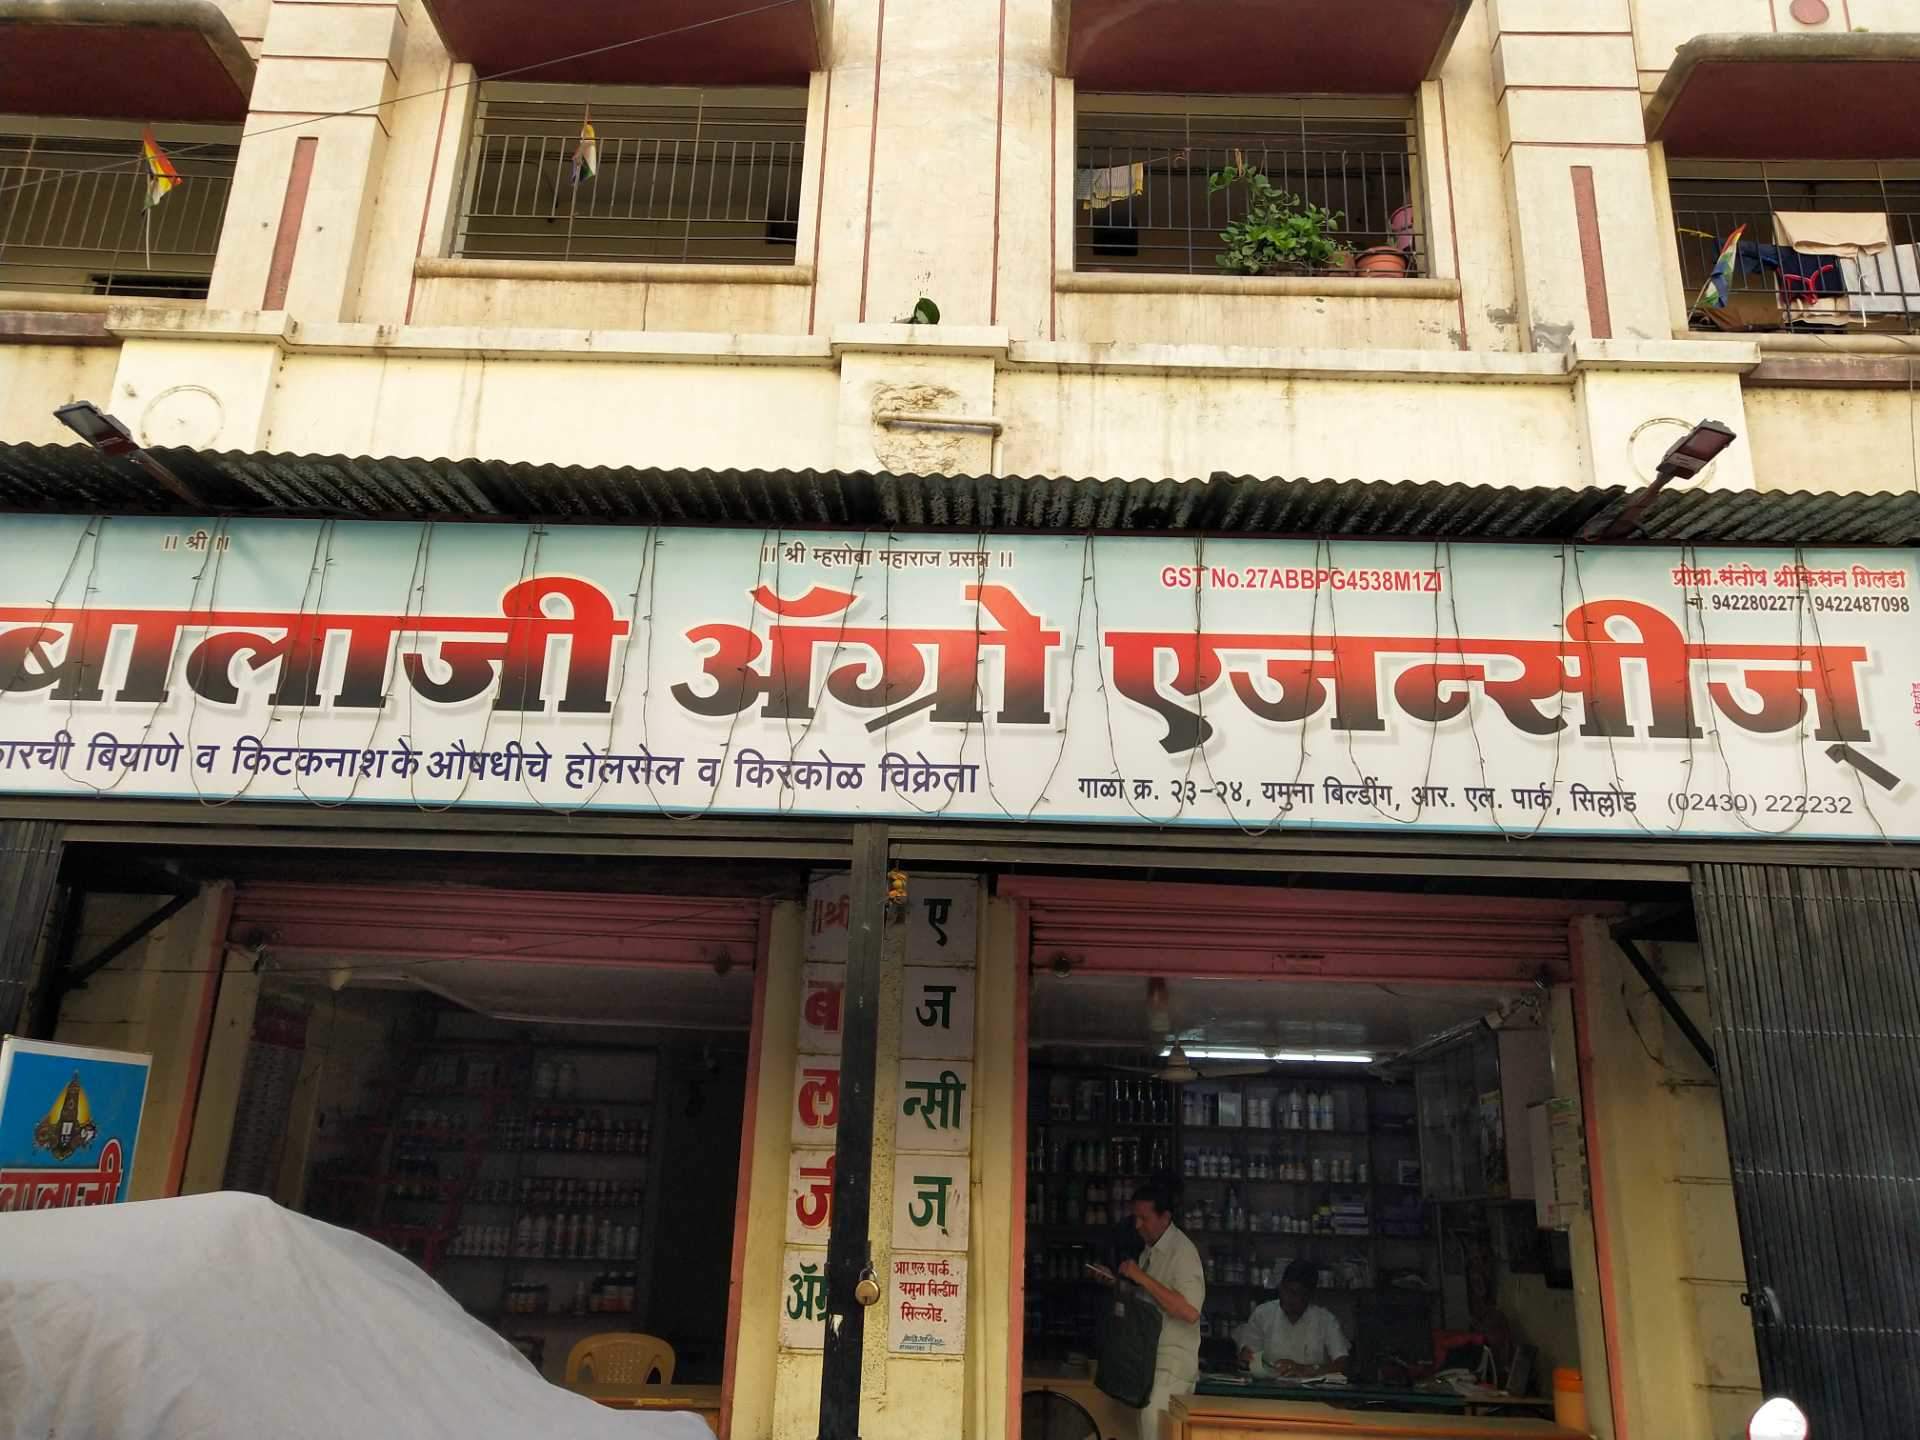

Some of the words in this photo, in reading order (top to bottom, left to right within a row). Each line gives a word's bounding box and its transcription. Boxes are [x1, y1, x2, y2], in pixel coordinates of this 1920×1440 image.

[784, 542, 806, 564] श्री
[879, 550, 941, 569] महाराज
[1162, 567, 1207, 588] GST
[1815, 596, 1910, 612] 9422487098
[86, 731, 185, 773] बियाणे
[195, 745, 220, 774] व
[565, 742, 685, 789] होलसेल
[697, 758, 721, 787] व
[734, 748, 866, 791] किरकोळ
[878, 751, 980, 793] विक्रेता
[1078, 777, 1124, 800] गाळा
[1133, 778, 1160, 800] क्र.
[1261, 782, 1315, 811] यमुना
[1411, 786, 1456, 807] आर.
[1464, 787, 1503, 812] एल.
[1569, 782, 1637, 817] सिल्लोड
[1667, 792, 1758, 815] (02430)
[1765, 793, 1853, 815] 222232
